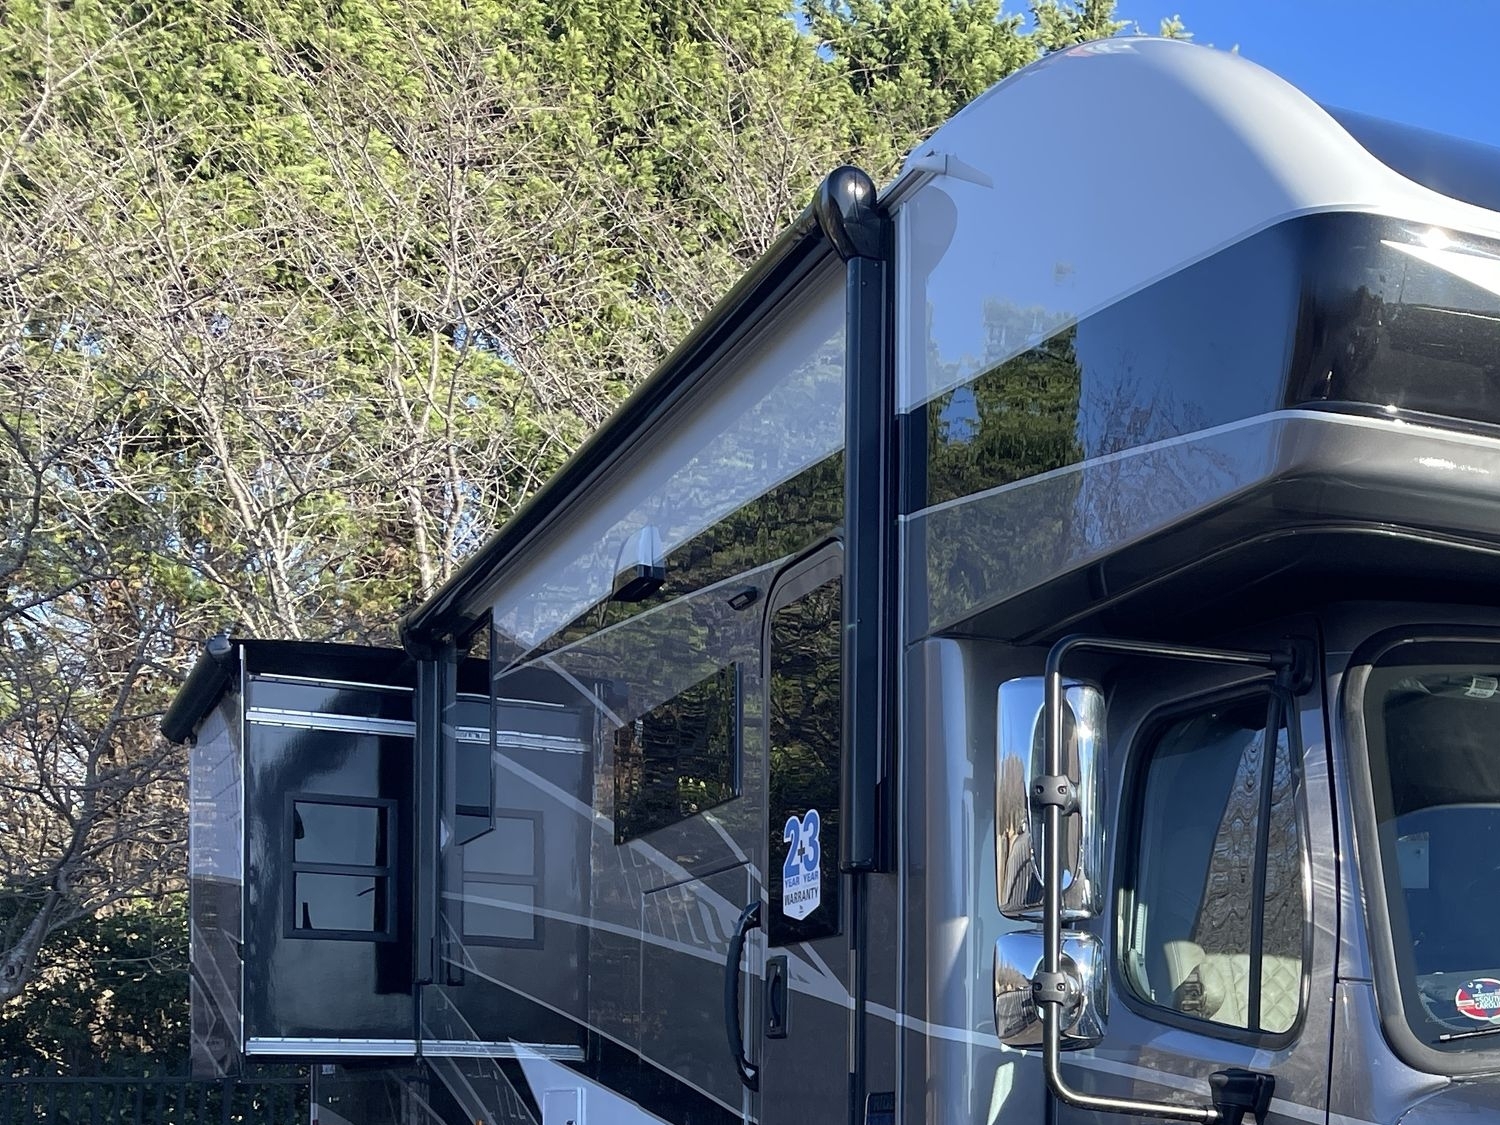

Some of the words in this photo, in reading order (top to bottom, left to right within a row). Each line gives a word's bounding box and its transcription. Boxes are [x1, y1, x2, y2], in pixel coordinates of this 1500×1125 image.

[785, 876, 800, 889] YEAR
[803, 871, 819, 884] YEAR
[784, 886, 819, 906] WARRANTY
